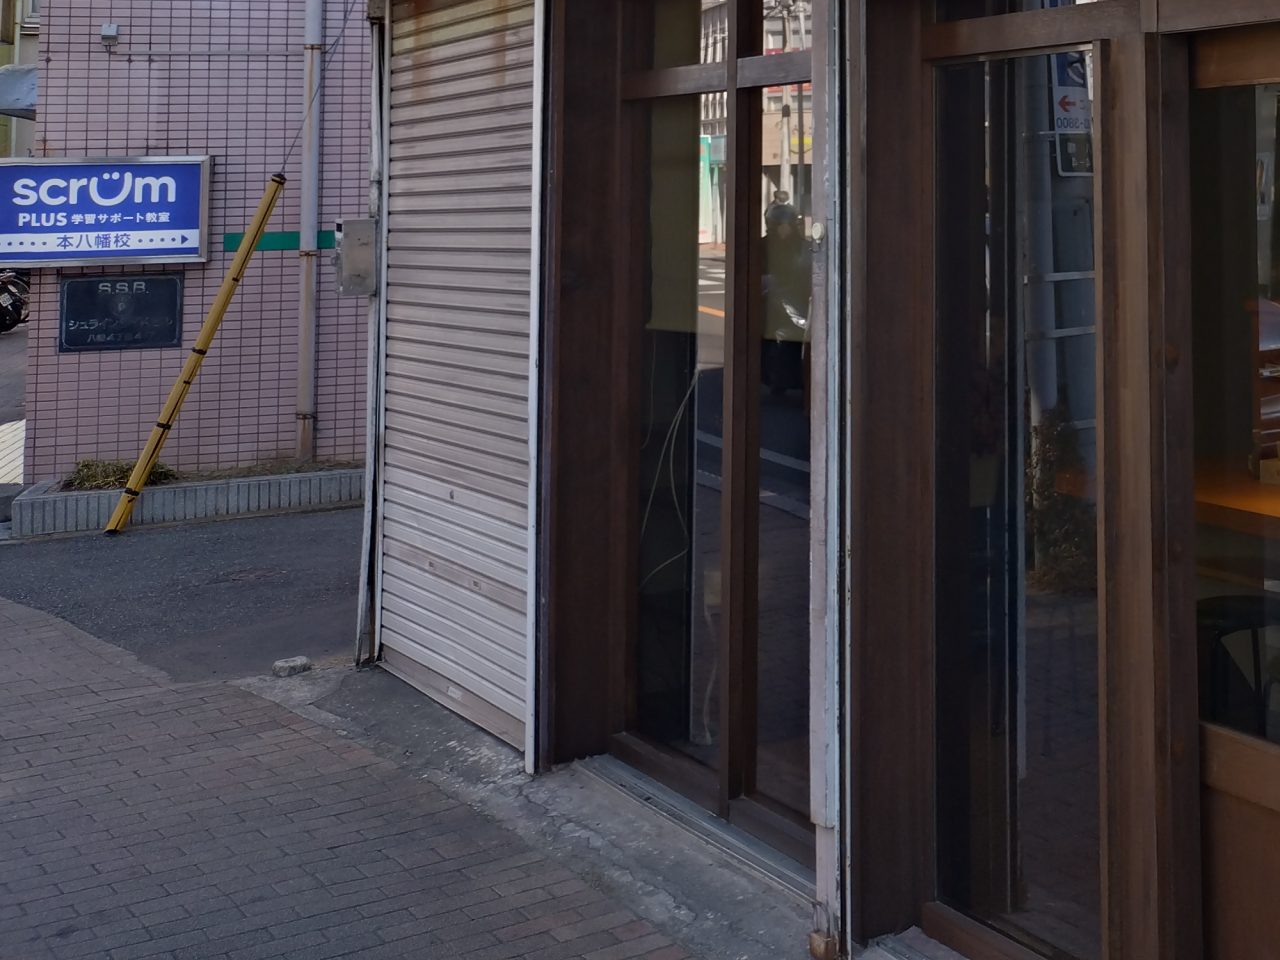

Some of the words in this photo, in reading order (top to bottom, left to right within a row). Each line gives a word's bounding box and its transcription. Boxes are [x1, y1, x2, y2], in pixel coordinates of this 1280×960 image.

[18, 213, 67, 227] PLUS
[71, 212, 171, 225] 学習サポート教室
[56, 233, 131, 250] 本八幡校
